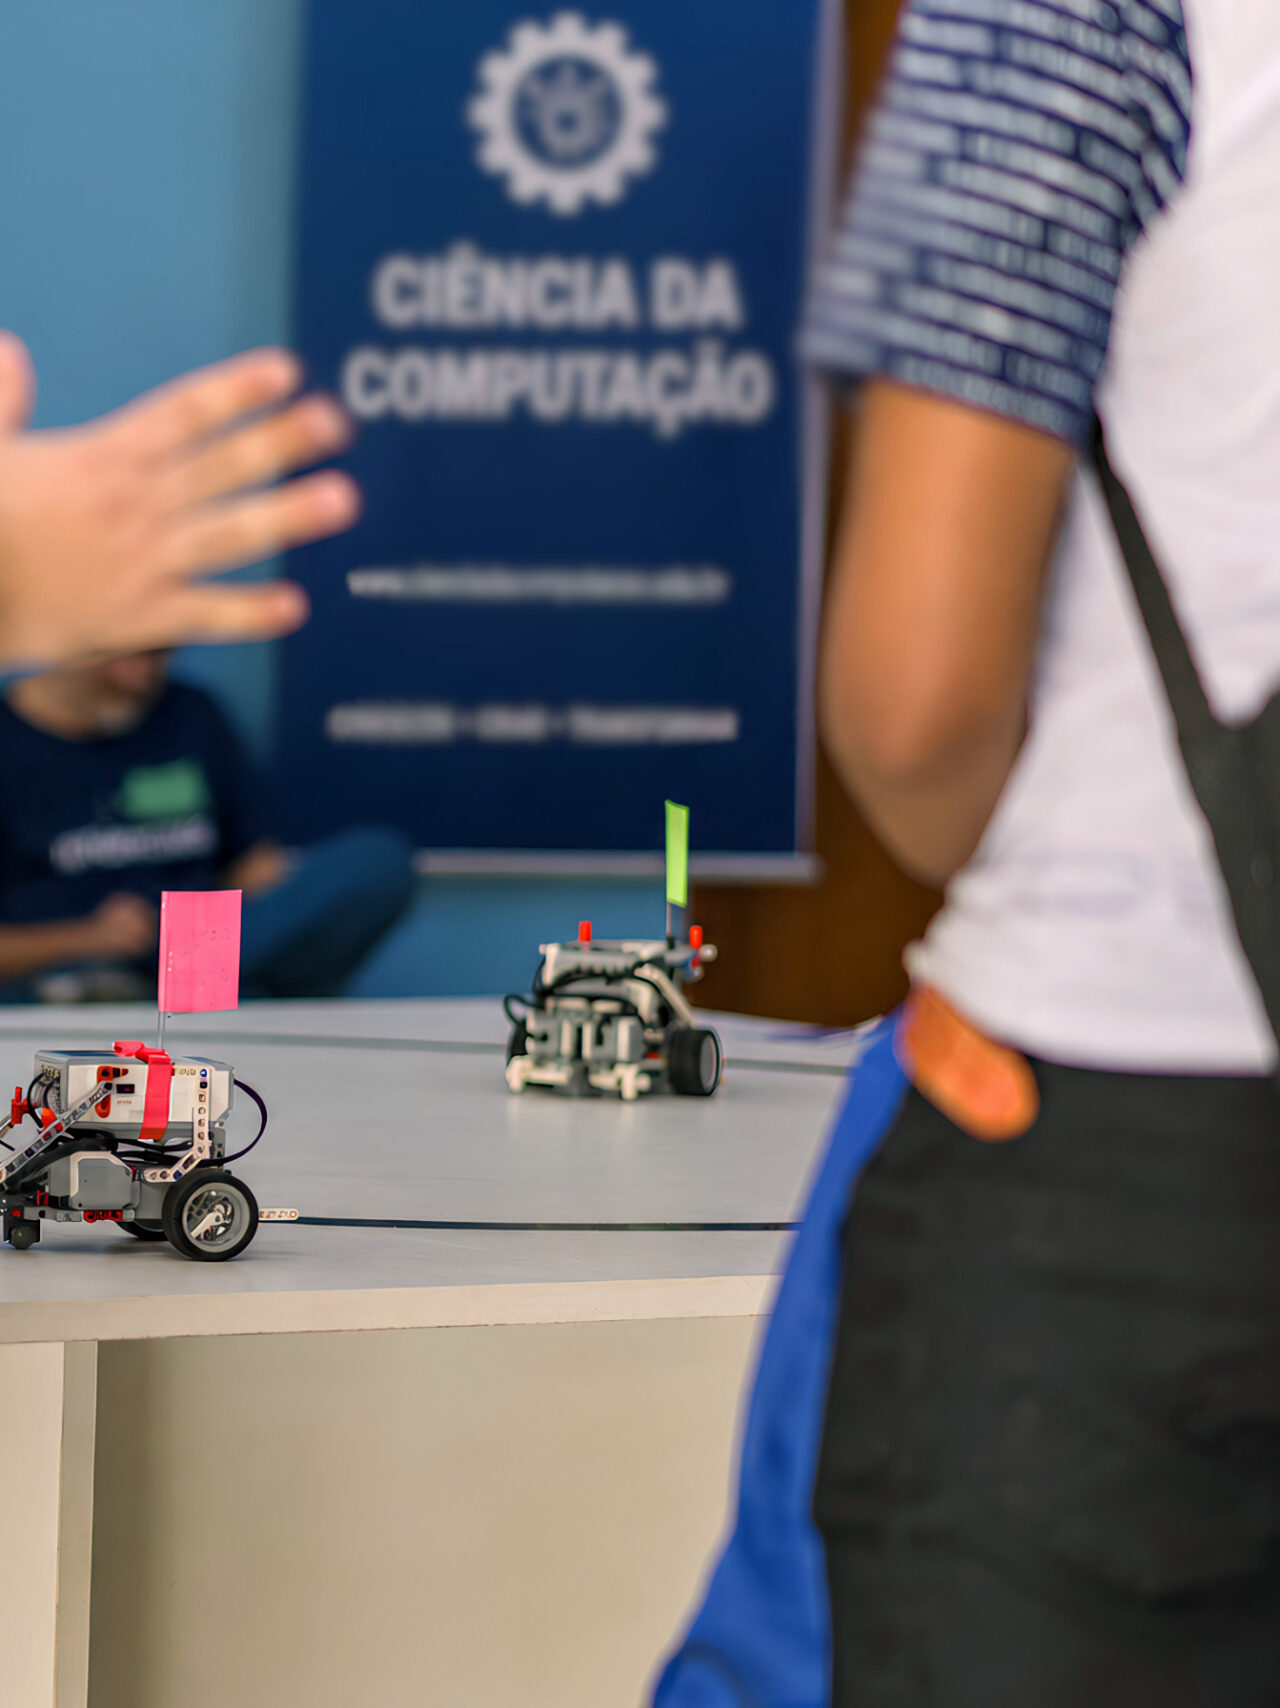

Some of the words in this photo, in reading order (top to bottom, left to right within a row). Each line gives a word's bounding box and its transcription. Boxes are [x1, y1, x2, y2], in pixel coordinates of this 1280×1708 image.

[373, 240, 636, 329] CIÊNCIA
[651, 258, 744, 329] DA
[342, 338, 773, 437] COMPUTAÇÃO
